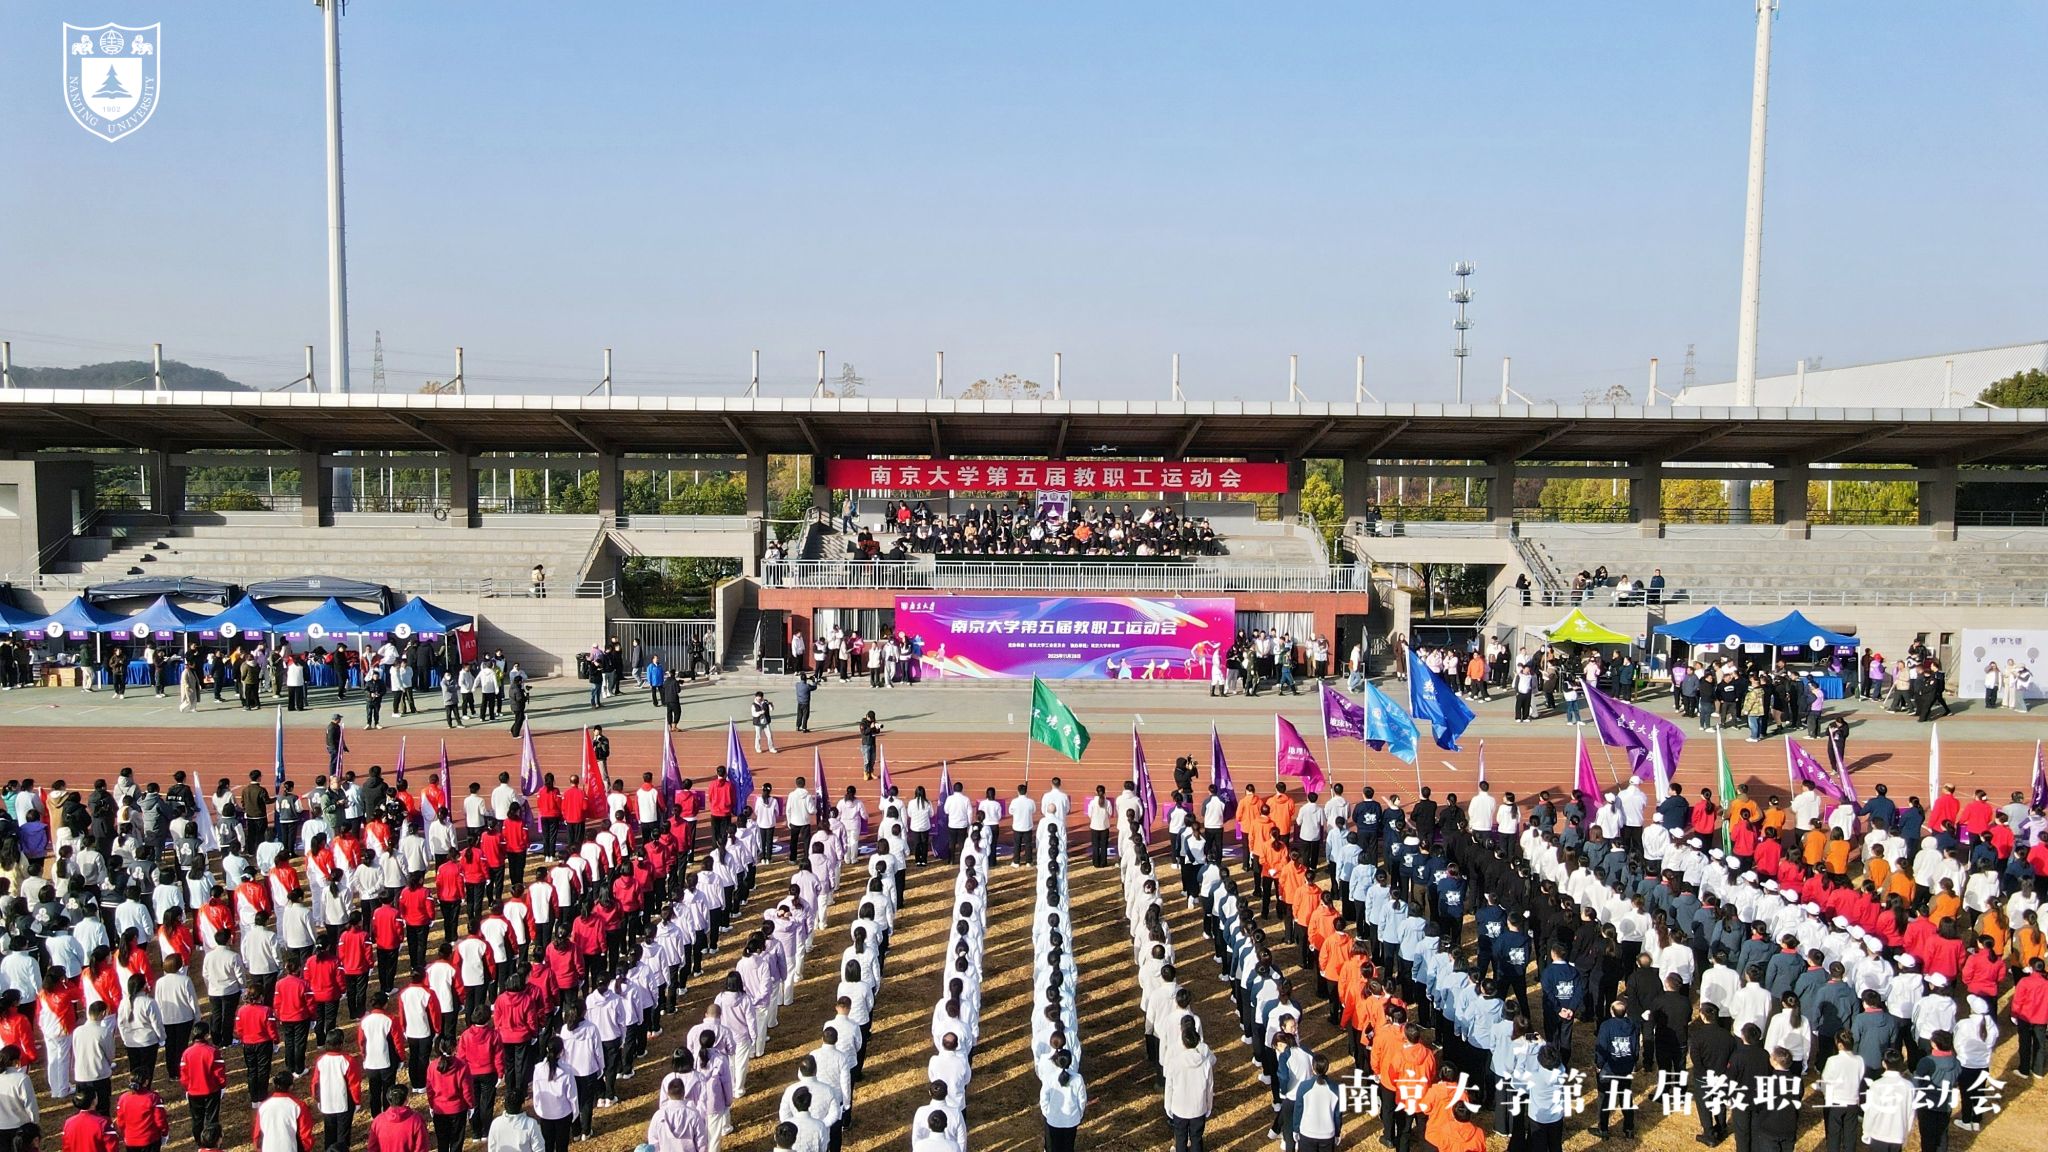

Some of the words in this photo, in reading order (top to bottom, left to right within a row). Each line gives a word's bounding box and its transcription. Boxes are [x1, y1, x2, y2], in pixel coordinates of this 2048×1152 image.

[869, 465, 1243, 489] 南京大学第五届教职工运动会
[951, 619, 1178, 636] 南京大学第五届教职工运动会
